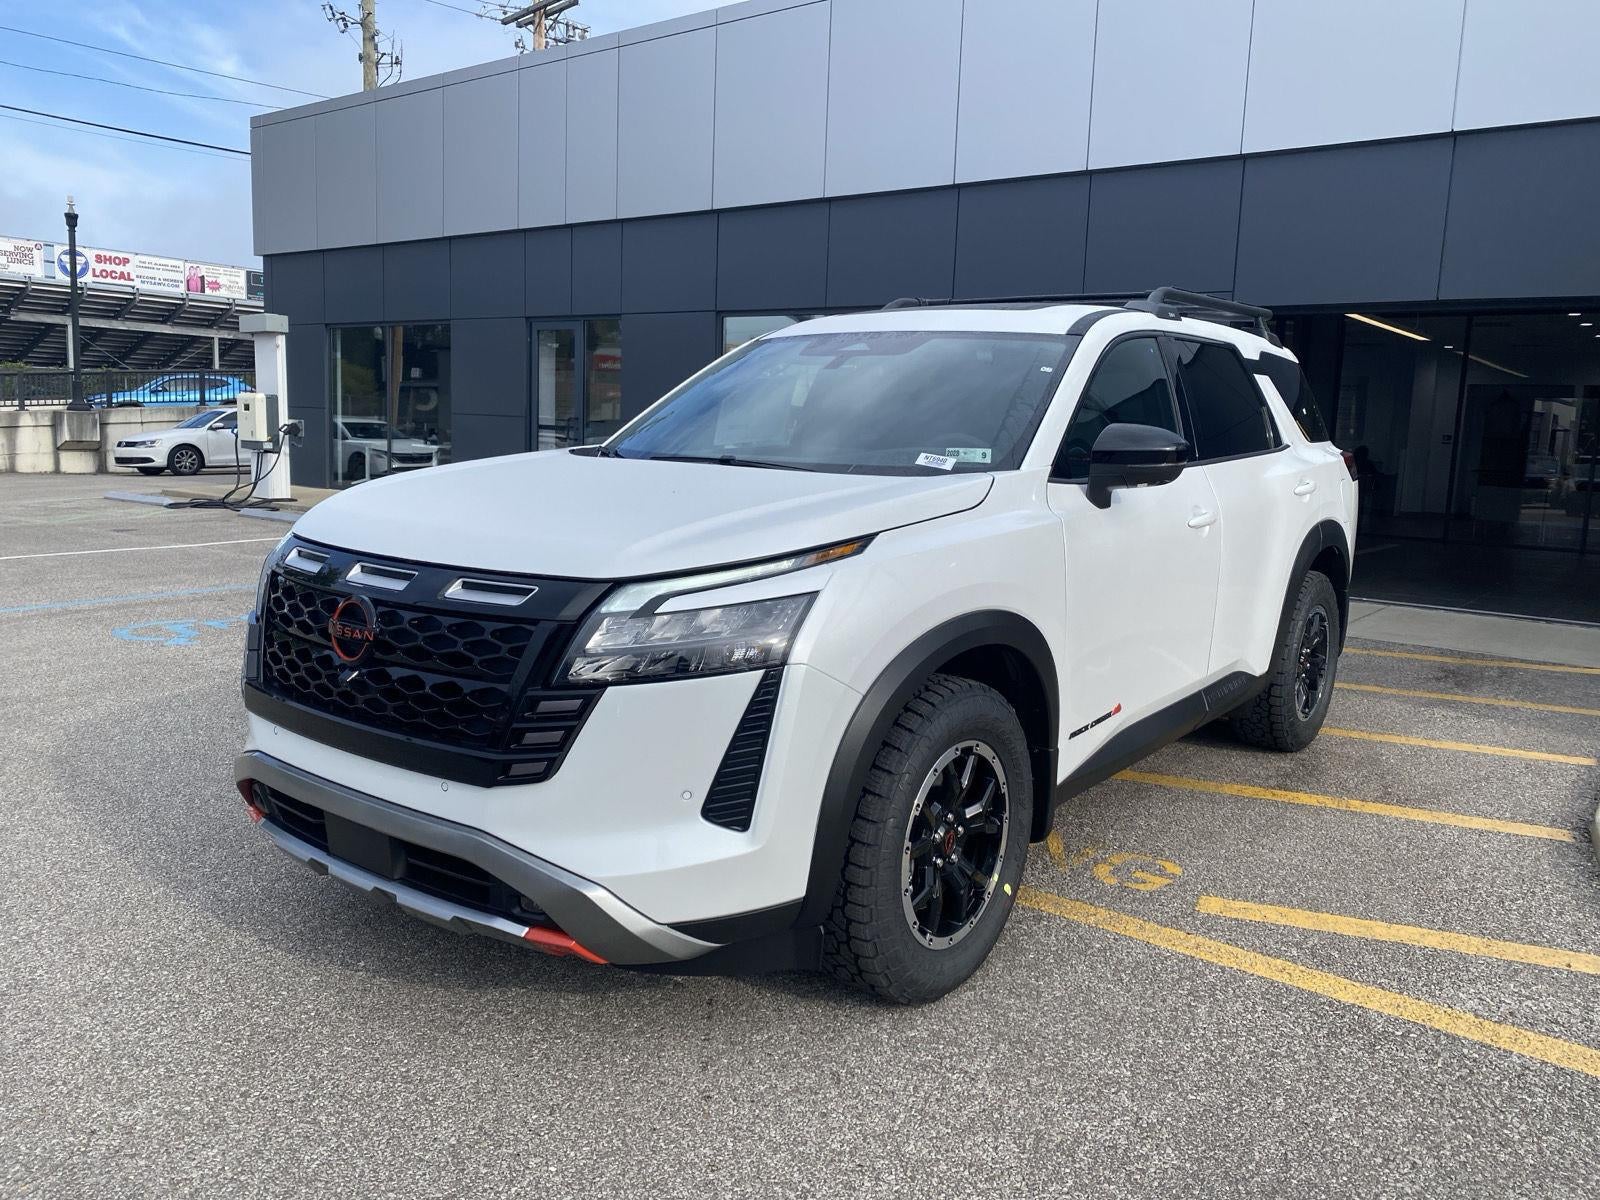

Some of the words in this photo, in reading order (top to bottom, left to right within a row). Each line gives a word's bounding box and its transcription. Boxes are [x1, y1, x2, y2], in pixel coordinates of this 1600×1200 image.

[0, 250, 34, 259] SERVING
[95, 254, 130, 266] SHOP
[6, 256, 34, 266] LUNCH
[92, 268, 134, 282] LOCAL
